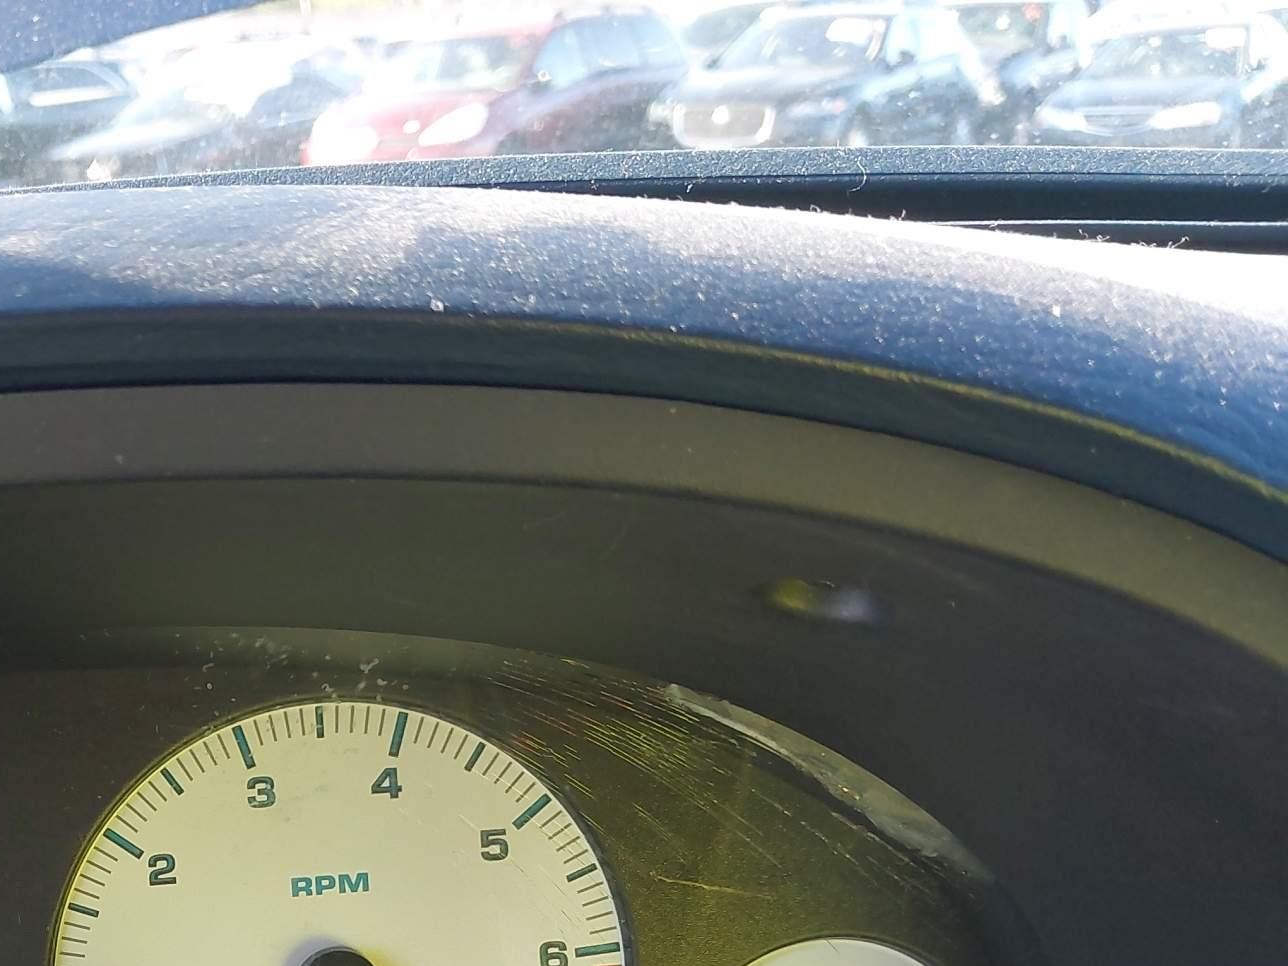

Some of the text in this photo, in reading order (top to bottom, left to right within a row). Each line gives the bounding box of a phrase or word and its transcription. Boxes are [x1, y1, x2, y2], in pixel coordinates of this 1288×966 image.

[247, 777, 277, 808] 3
[371, 768, 402, 799] 4
[480, 829, 509, 861] 5
[147, 854, 177, 886] 2
[290, 872, 370, 898] RPM
